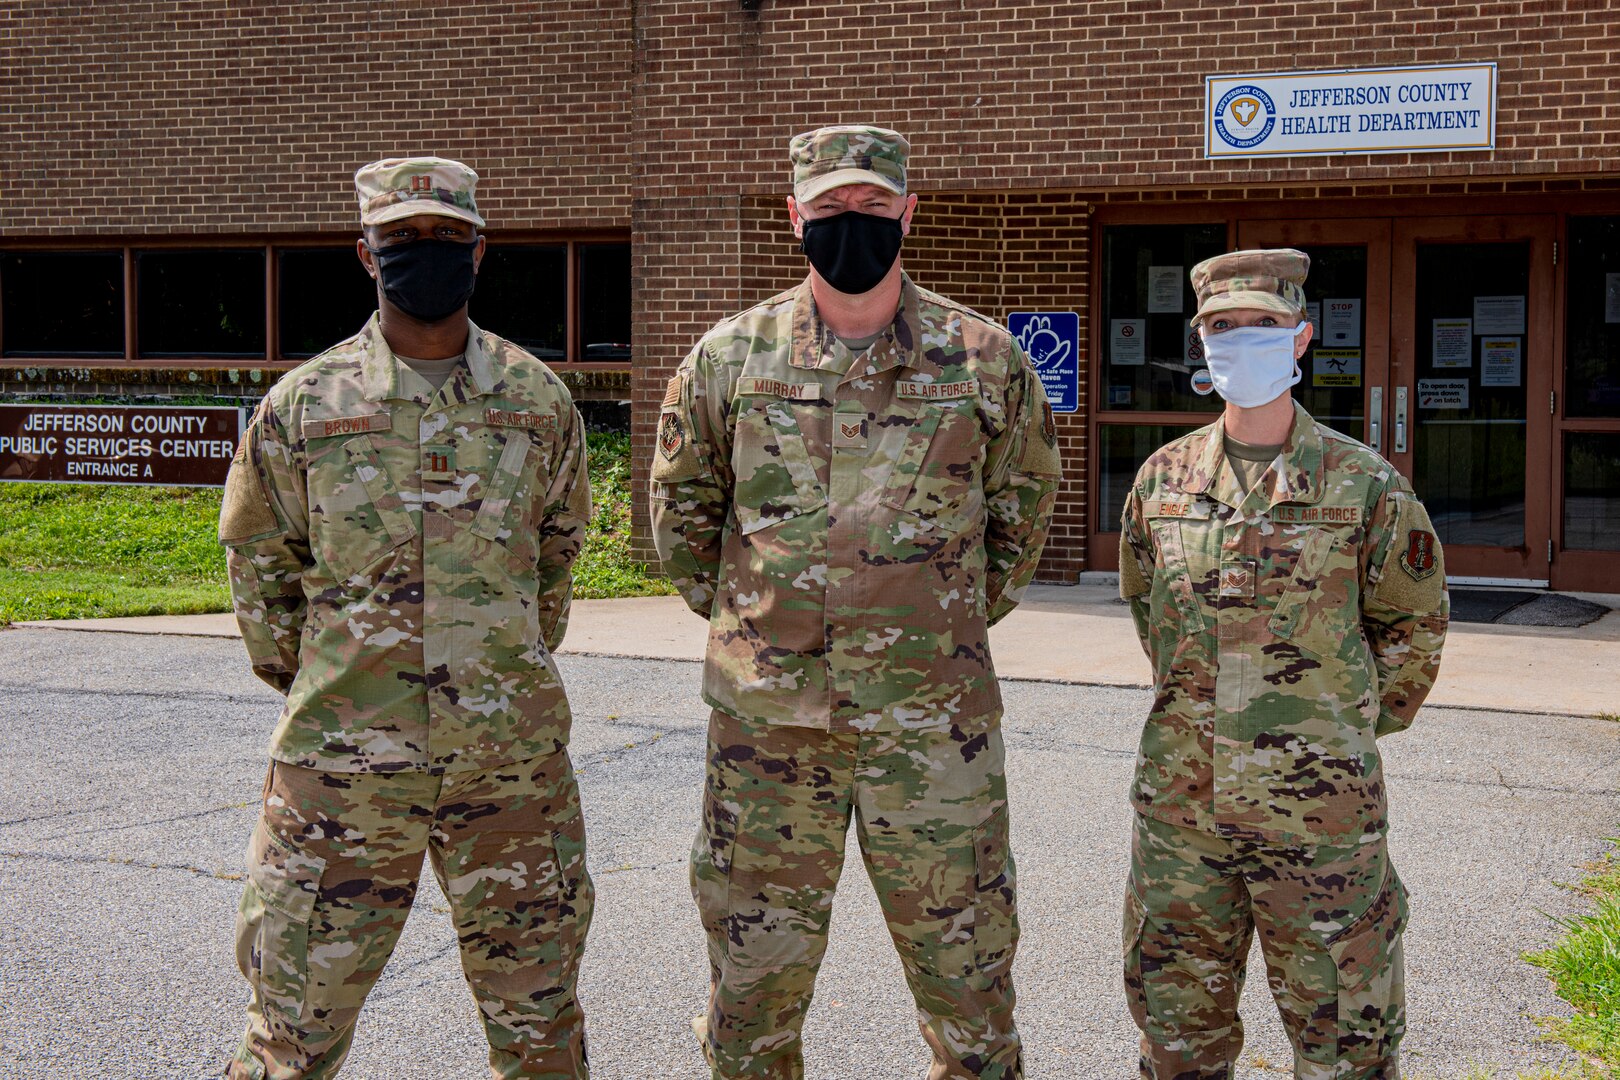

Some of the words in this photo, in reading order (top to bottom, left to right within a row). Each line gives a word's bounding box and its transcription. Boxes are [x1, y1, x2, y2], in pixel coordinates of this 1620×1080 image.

[1217, 88, 1250, 114] JEFFERSON
[1252, 90, 1273, 112] COUNTY
[1290, 86, 1391, 108] JEFFERSON
[1398, 82, 1472, 103] COUNTY
[1281, 115, 1350, 135] HEALTH
[1358, 110, 1480, 131] DEPARTMENT
[1217, 123, 1236, 144] HEALTH
[1236, 121, 1273, 146] DEPARTMENT
[754, 380, 805, 398] MURRAY
[902, 384, 918, 396] U.S.
[922, 385, 937, 397] AIR
[941, 382, 973, 396] FORCE
[24, 414, 124, 433] JEFFERSON
[131, 415, 207, 434] COUNTY
[324, 417, 370, 435] BROWN
[488, 410, 504, 424] U.S.
[507, 413, 522, 426] AIR
[525, 414, 555, 429] FORCE
[0, 436, 58, 455] PUBLIC
[65, 438, 152, 457] SERVICES
[160, 439, 234, 458] CENTER
[67, 462, 138, 477] ENTRANCE
[144, 464, 153, 478] A
[1159, 504, 1189, 516] ENGLE
[1279, 508, 1296, 520] U.S.
[1301, 508, 1318, 520] AIR
[1322, 508, 1357, 520] FORCE
